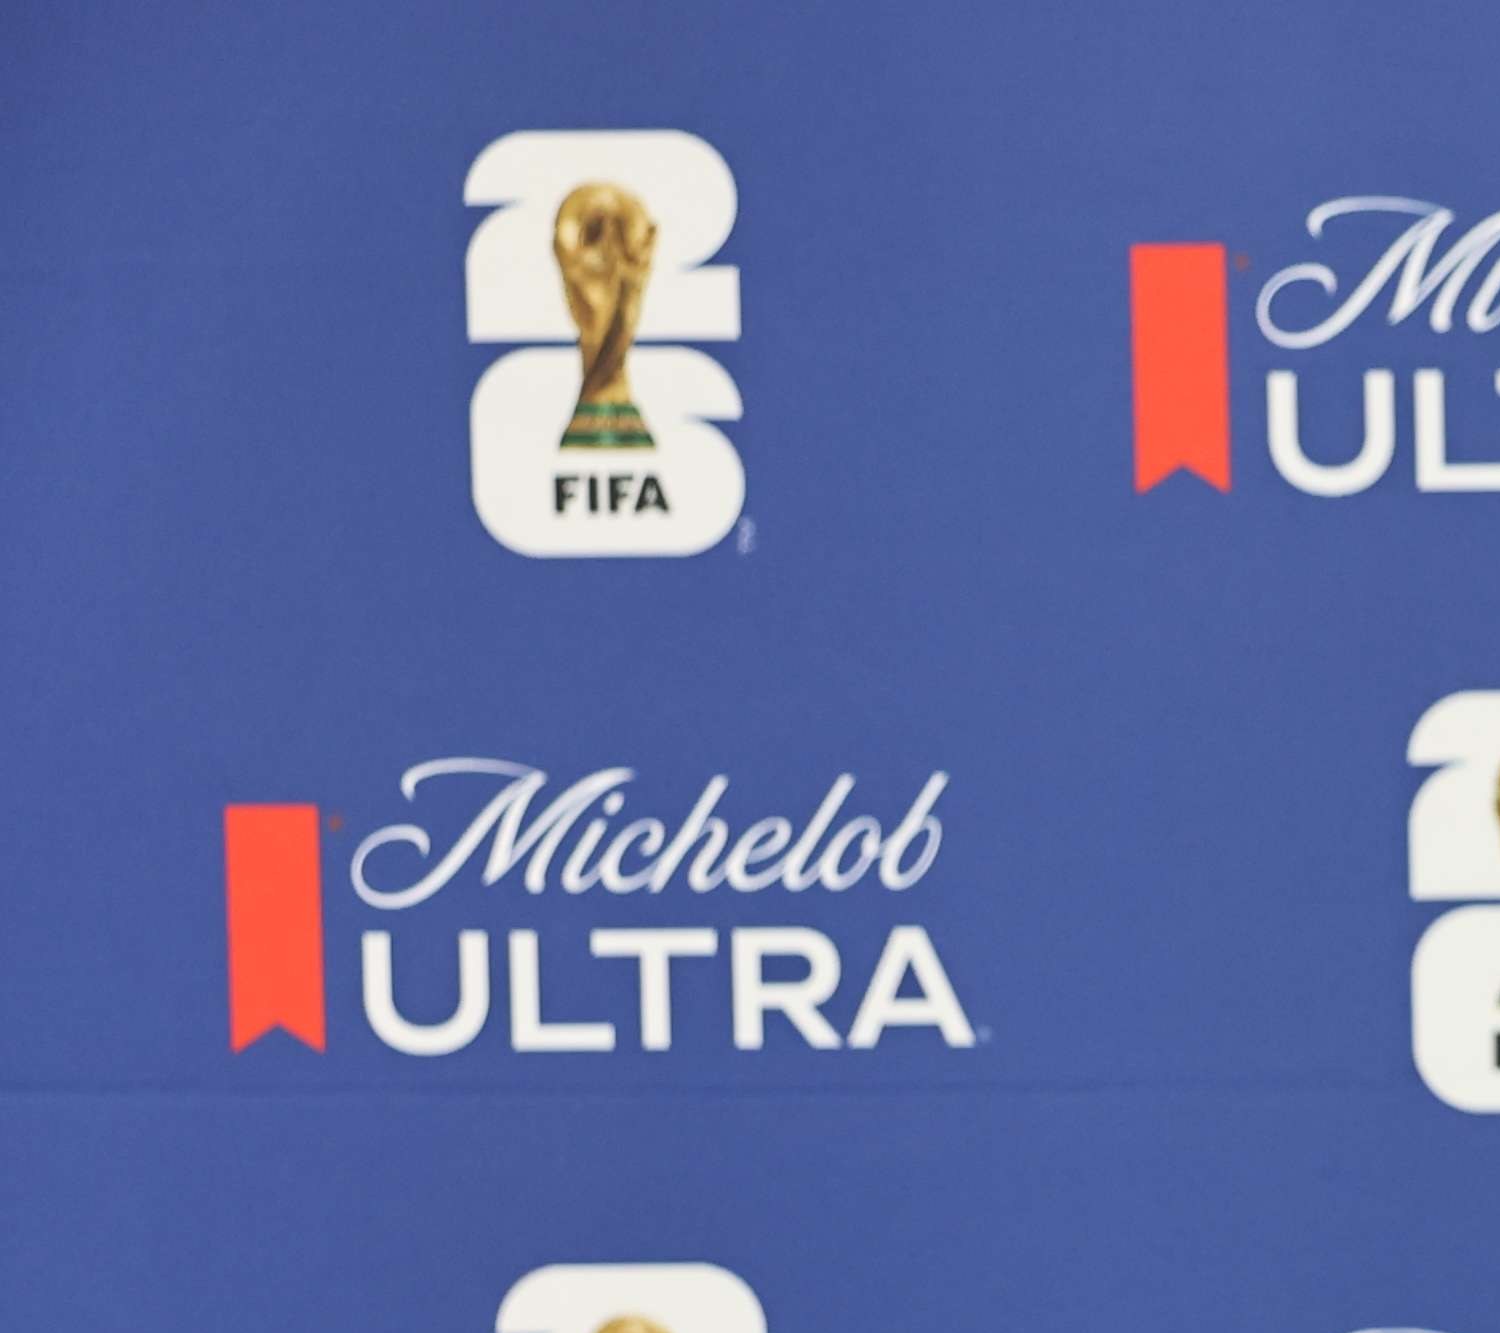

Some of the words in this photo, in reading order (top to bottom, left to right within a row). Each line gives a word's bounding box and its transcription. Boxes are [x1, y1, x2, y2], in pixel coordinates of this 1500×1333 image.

[553, 474, 670, 515] FIFA
[349, 756, 949, 911] Michelob
[360, 924, 977, 1057] ULTRA
